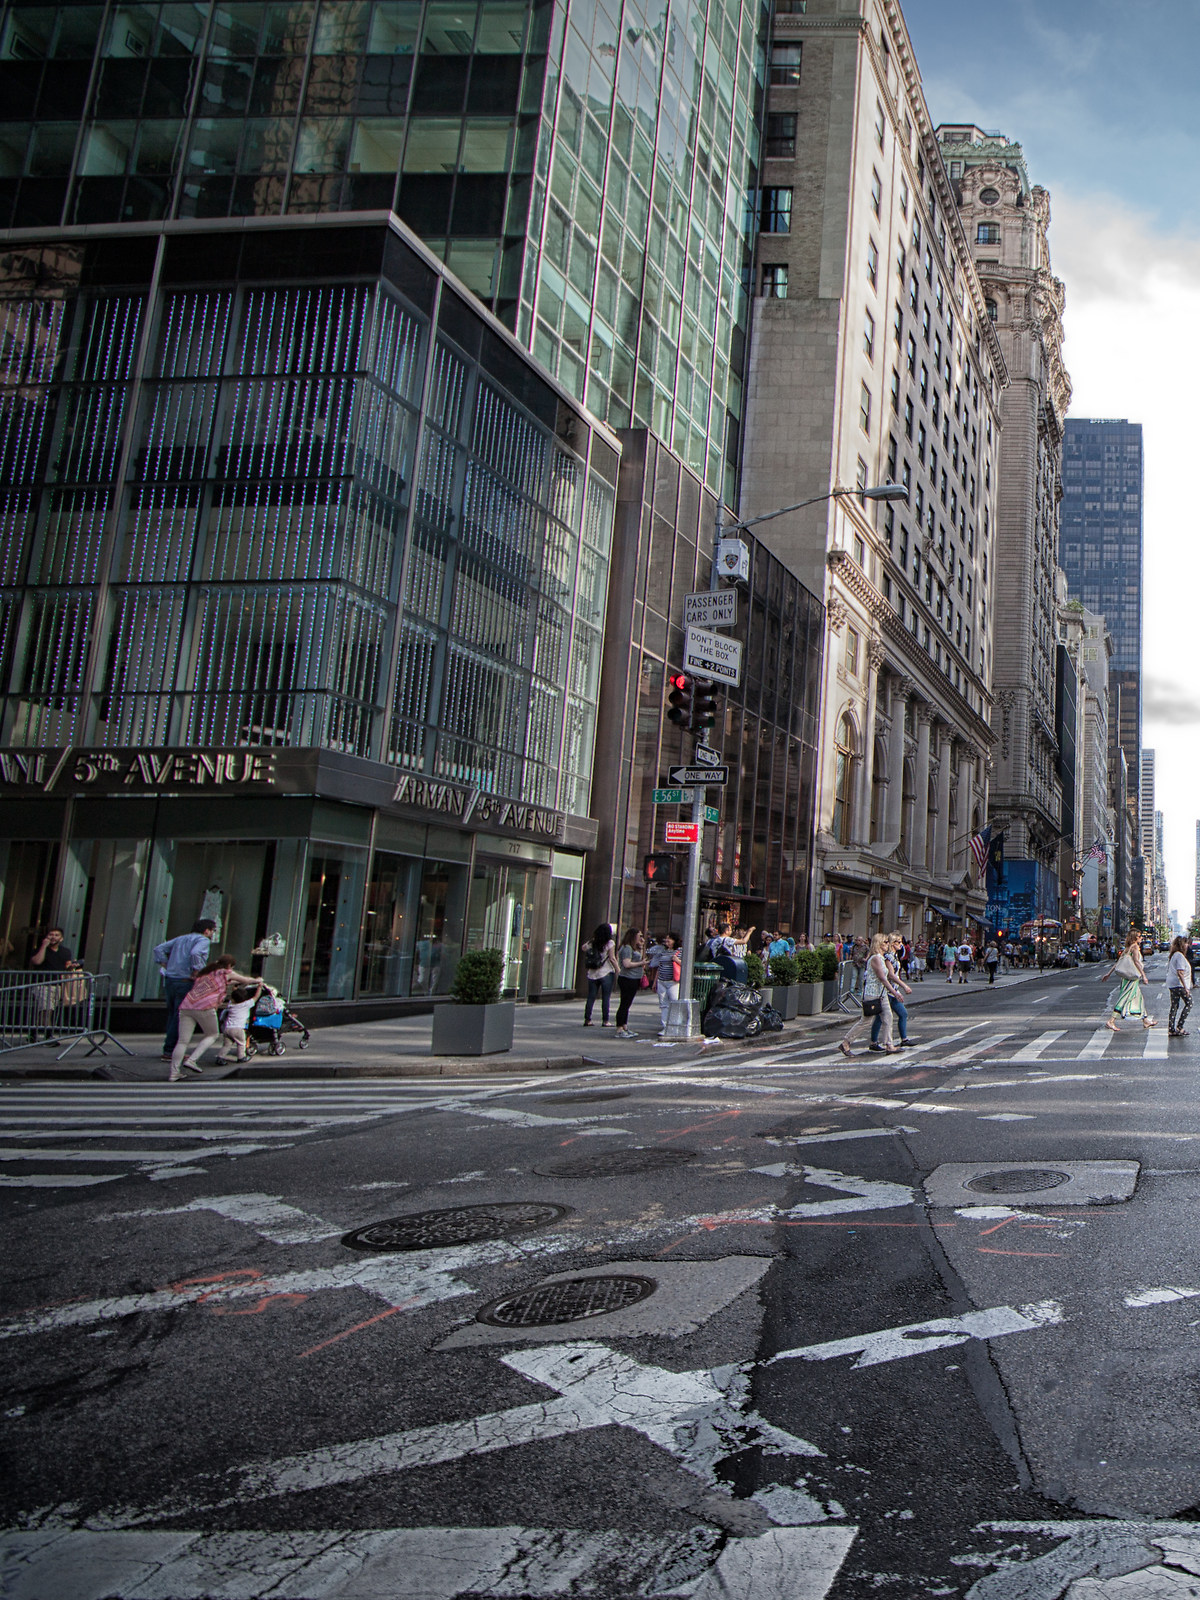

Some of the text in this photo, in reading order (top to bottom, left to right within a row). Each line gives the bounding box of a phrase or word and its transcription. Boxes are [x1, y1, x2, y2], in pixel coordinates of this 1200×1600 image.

[687, 594, 734, 609] PASSENGER
[686, 608, 733, 623] CARS ONLY
[691, 632, 738, 654] DON'T BLOCK
[699, 645, 729, 661] THE BOX
[690, 656, 704, 668] FINE
[715, 663, 736, 677] POINTS
[124, 753, 278, 784] AVENUE
[684, 771, 721, 780] ONE WAY
[654, 791, 659, 802] E
[500, 803, 565, 838] AVENUE
[508, 842, 521, 854] 717
